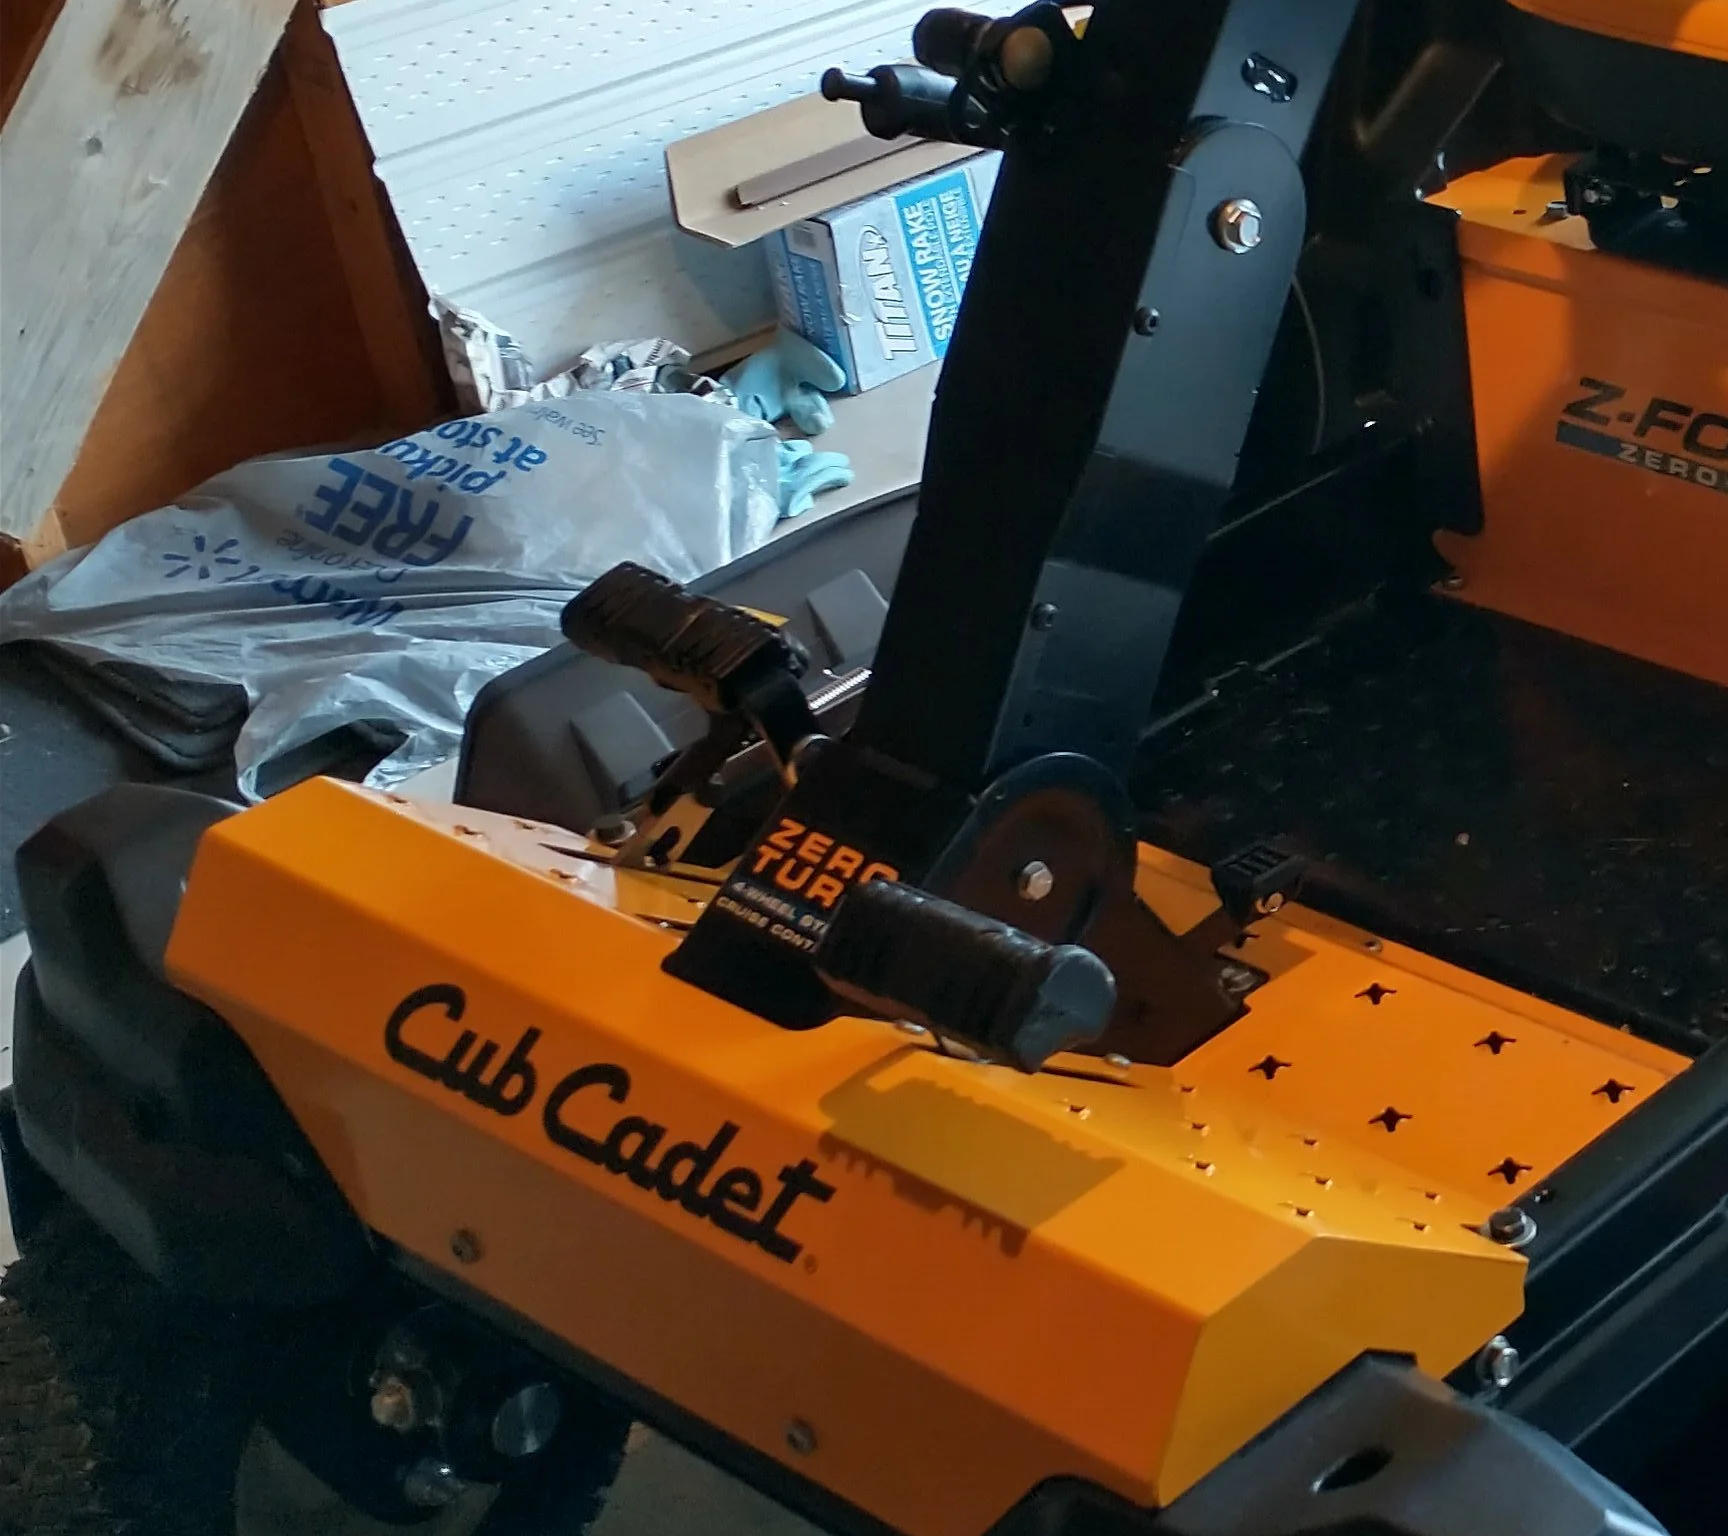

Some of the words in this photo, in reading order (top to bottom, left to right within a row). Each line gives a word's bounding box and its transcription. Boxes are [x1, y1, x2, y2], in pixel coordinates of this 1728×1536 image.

[903, 201, 929, 265] RAKE
[862, 246, 918, 360] TITAN
[919, 268, 952, 342] SNOW
[377, 438, 507, 495] picku
[429, 420, 503, 450] sto
[491, 435, 548, 472] at
[752, 844, 845, 909] TUR
[715, 895, 771, 929] CRUISE
[769, 922, 820, 954] CONT
[384, 982, 543, 1116] Cub
[542, 1062, 838, 1264] Cadet
